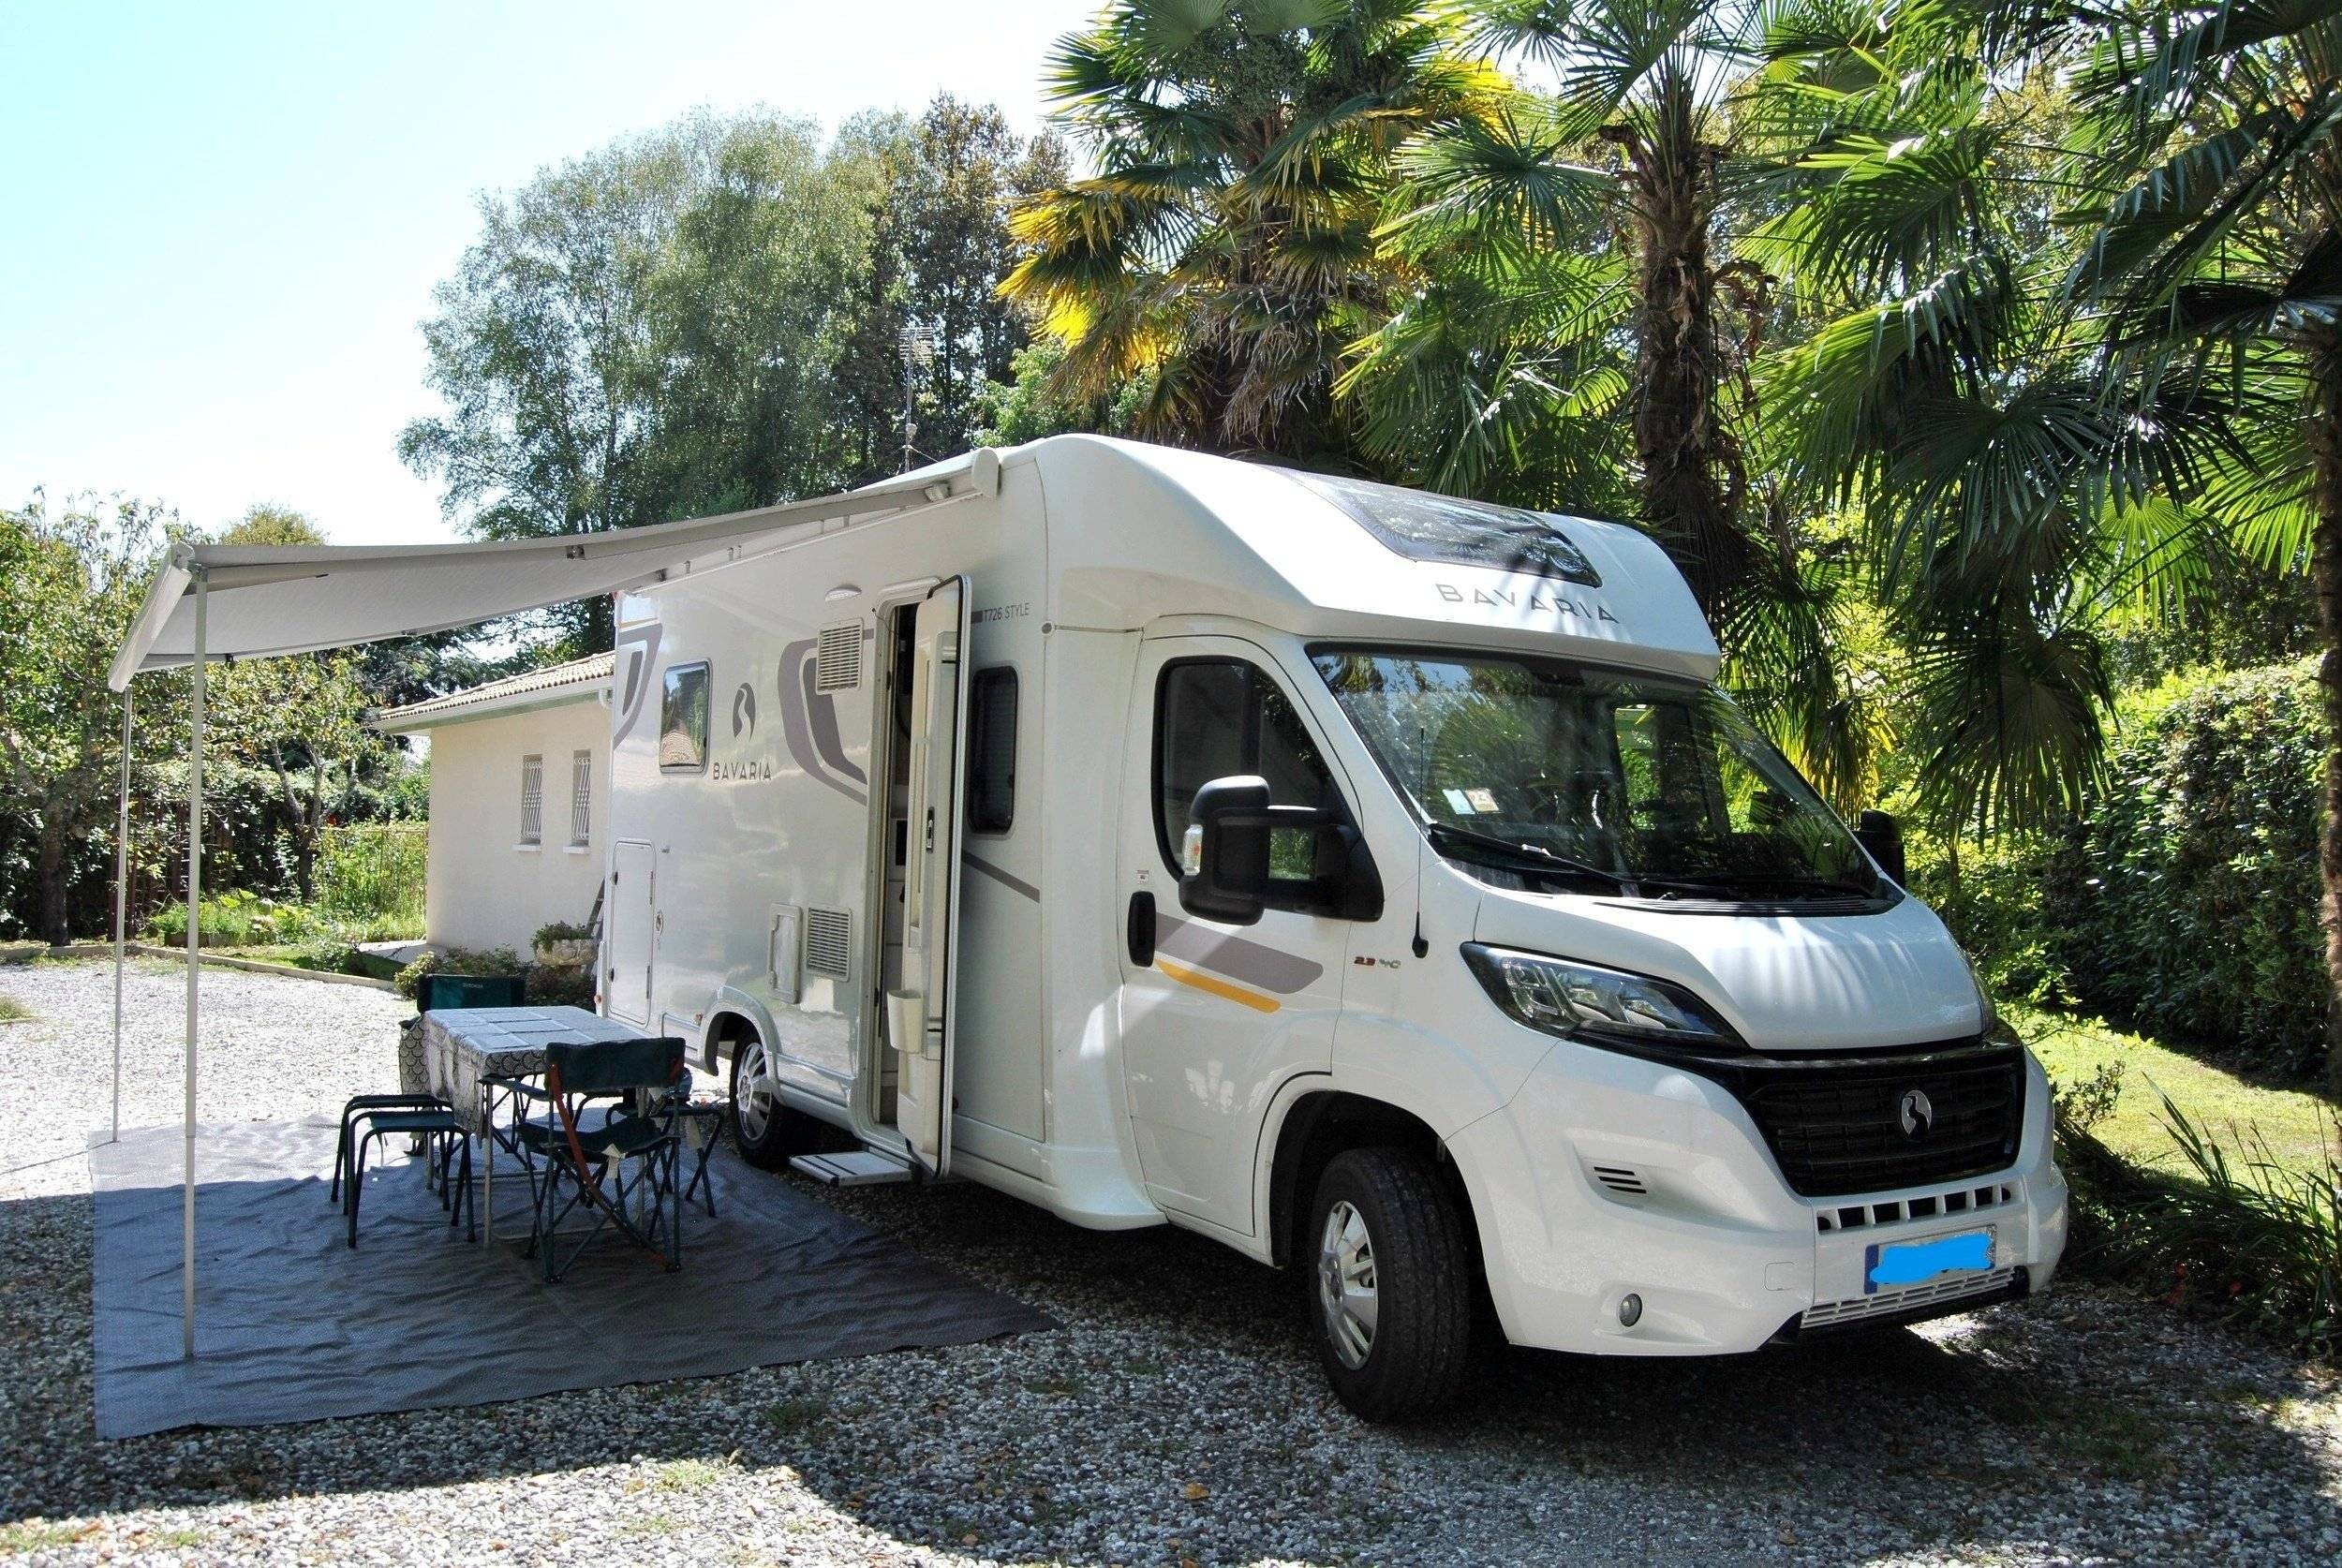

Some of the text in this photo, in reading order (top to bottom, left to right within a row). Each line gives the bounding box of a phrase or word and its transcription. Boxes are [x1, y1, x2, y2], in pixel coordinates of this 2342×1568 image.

[1004, 602, 1030, 619] STYLE
[1435, 583, 1620, 624] BAVARIA
[713, 762, 772, 780] BAVARIA
